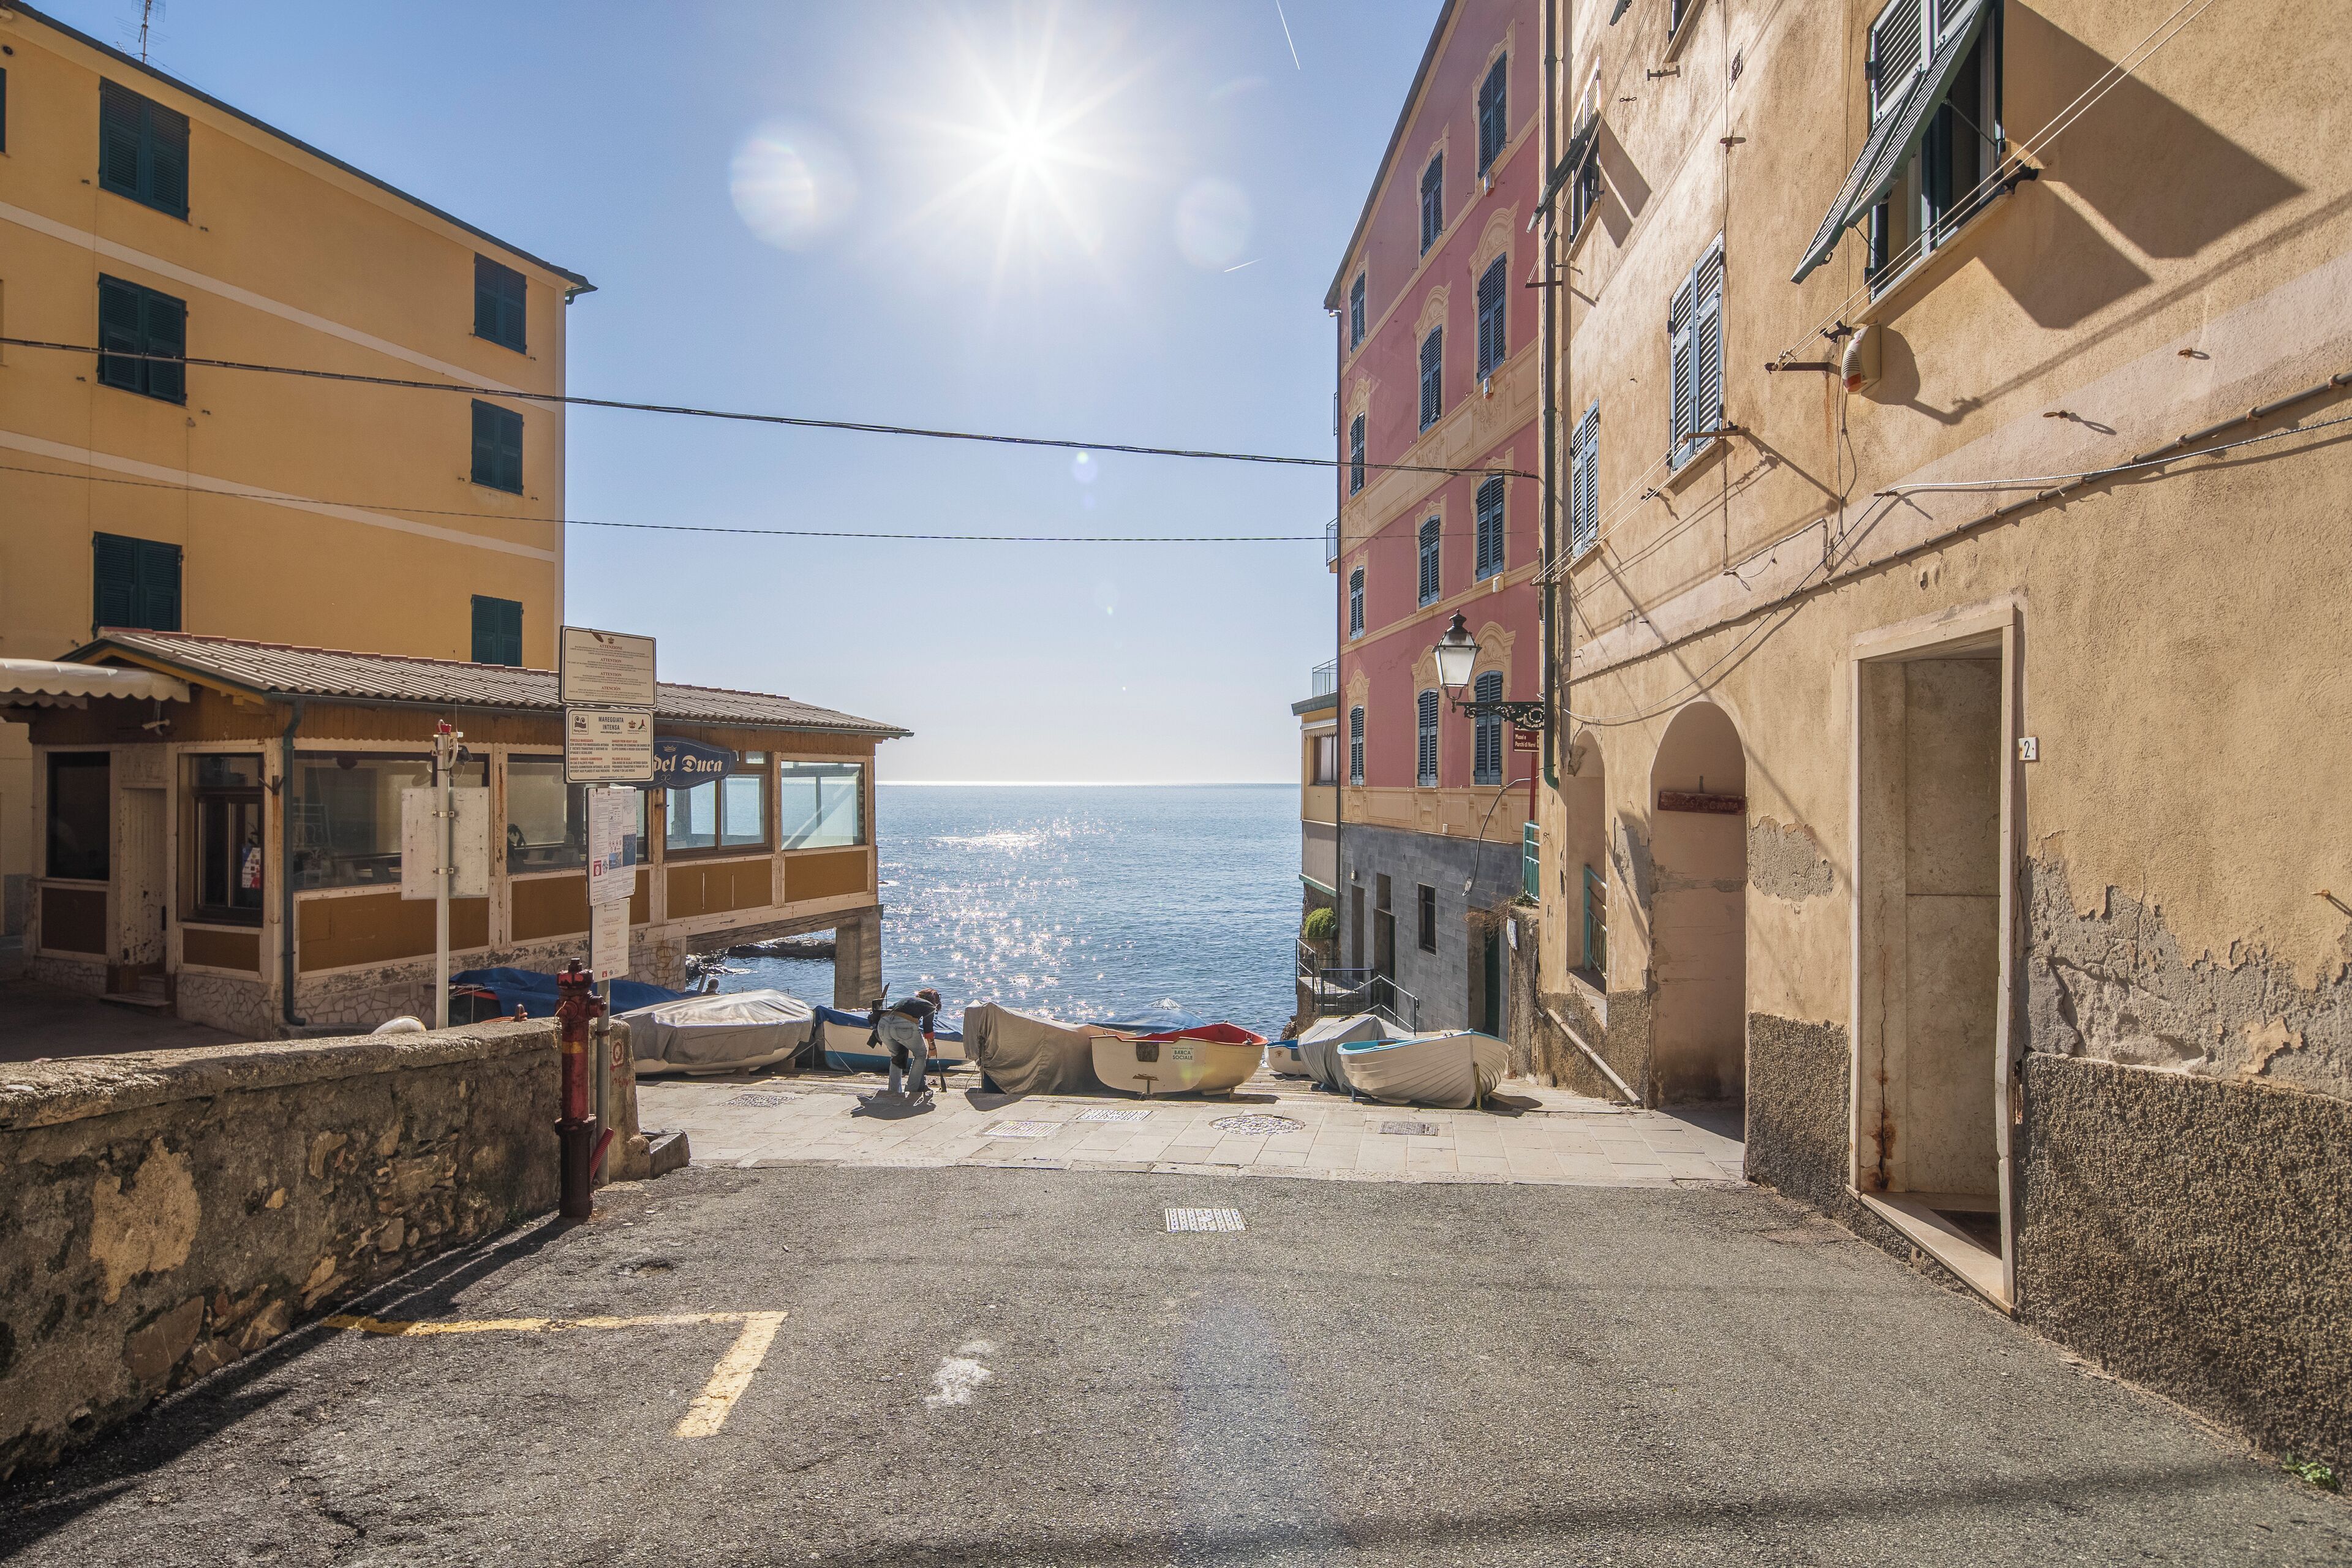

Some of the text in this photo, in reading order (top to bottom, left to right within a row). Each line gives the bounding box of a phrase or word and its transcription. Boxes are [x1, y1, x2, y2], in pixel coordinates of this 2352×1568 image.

[2024, 740, 2030, 758] 2
[654, 754, 723, 772] del Duca
